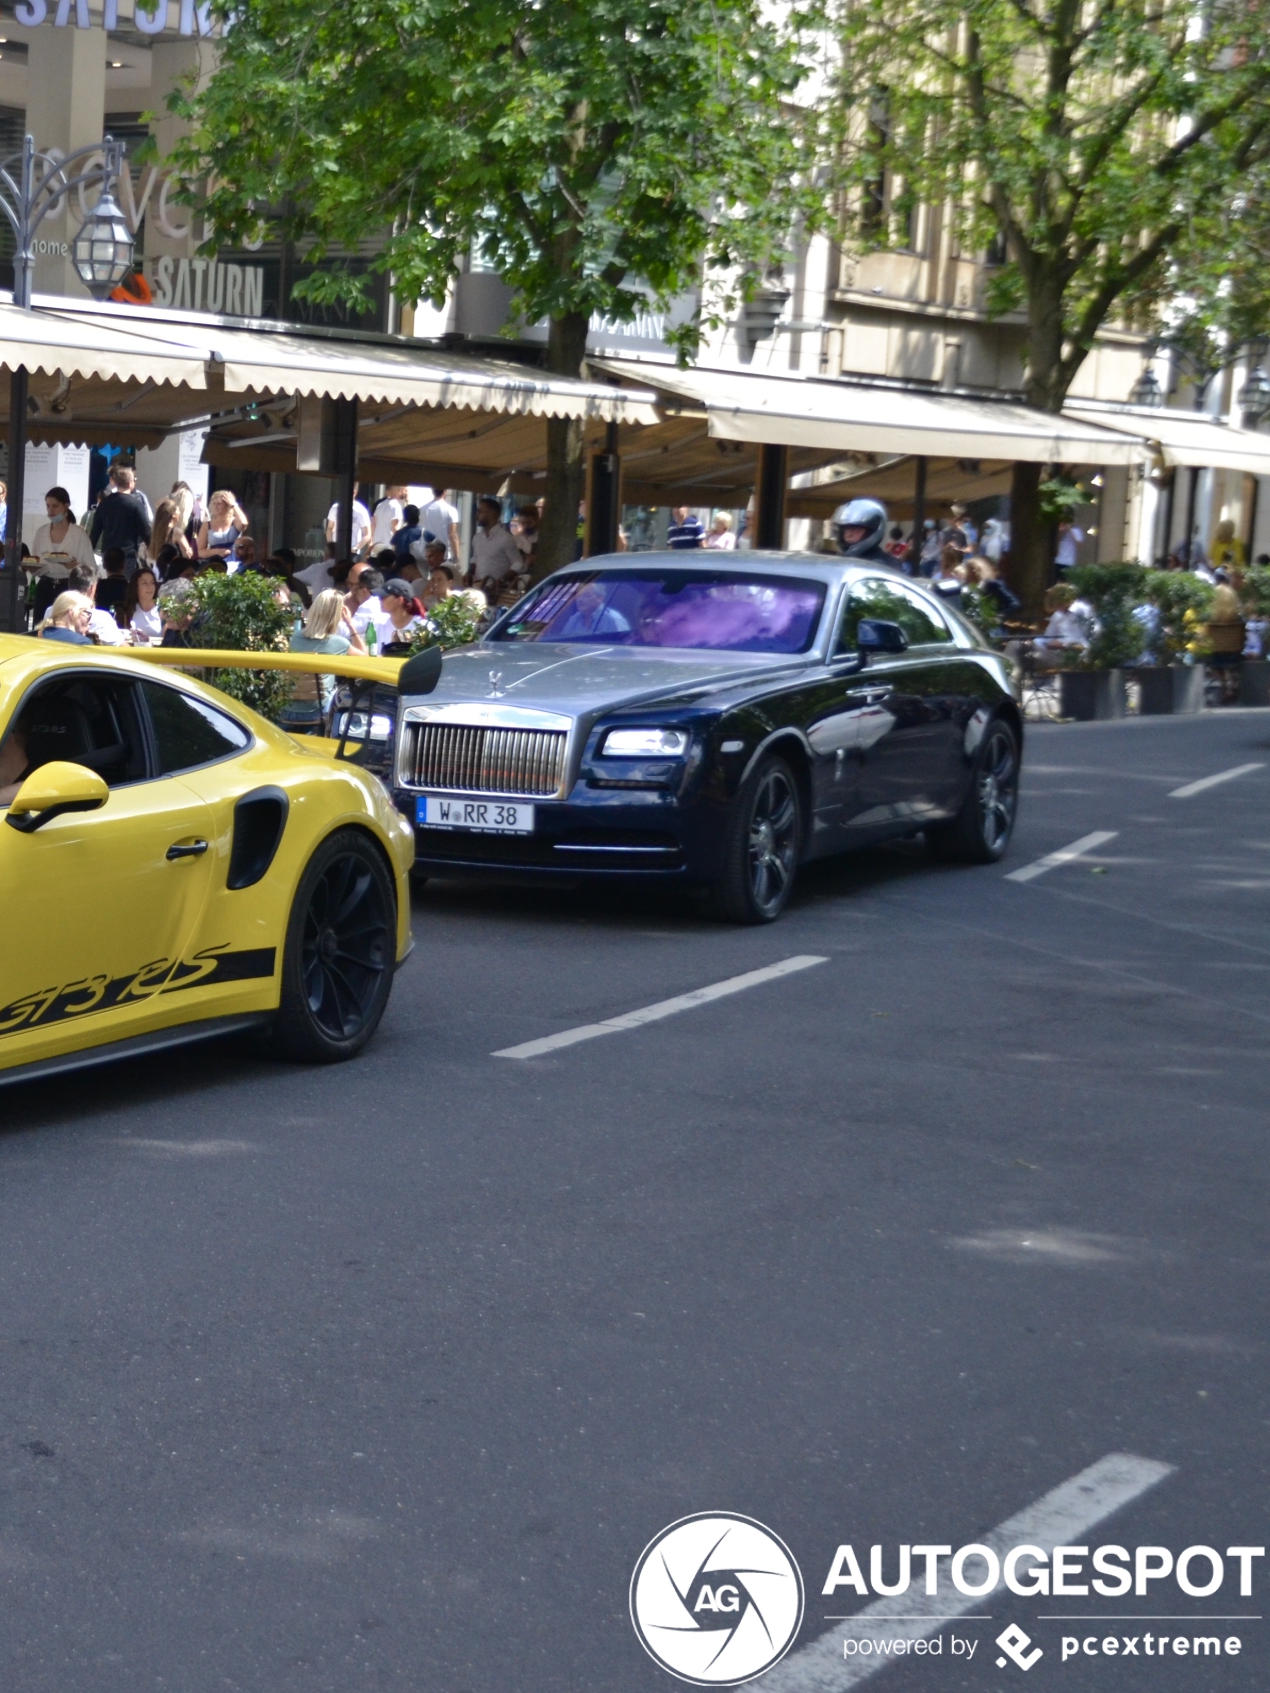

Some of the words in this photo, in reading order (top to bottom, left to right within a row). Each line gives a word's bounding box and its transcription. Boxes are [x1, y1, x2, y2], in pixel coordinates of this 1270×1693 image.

[157, 255, 264, 317] SATURN
[439, 802, 451, 821] W
[464, 804, 488, 824] RR
[494, 805, 517, 826] 38
[117, 942, 232, 1002] RS
